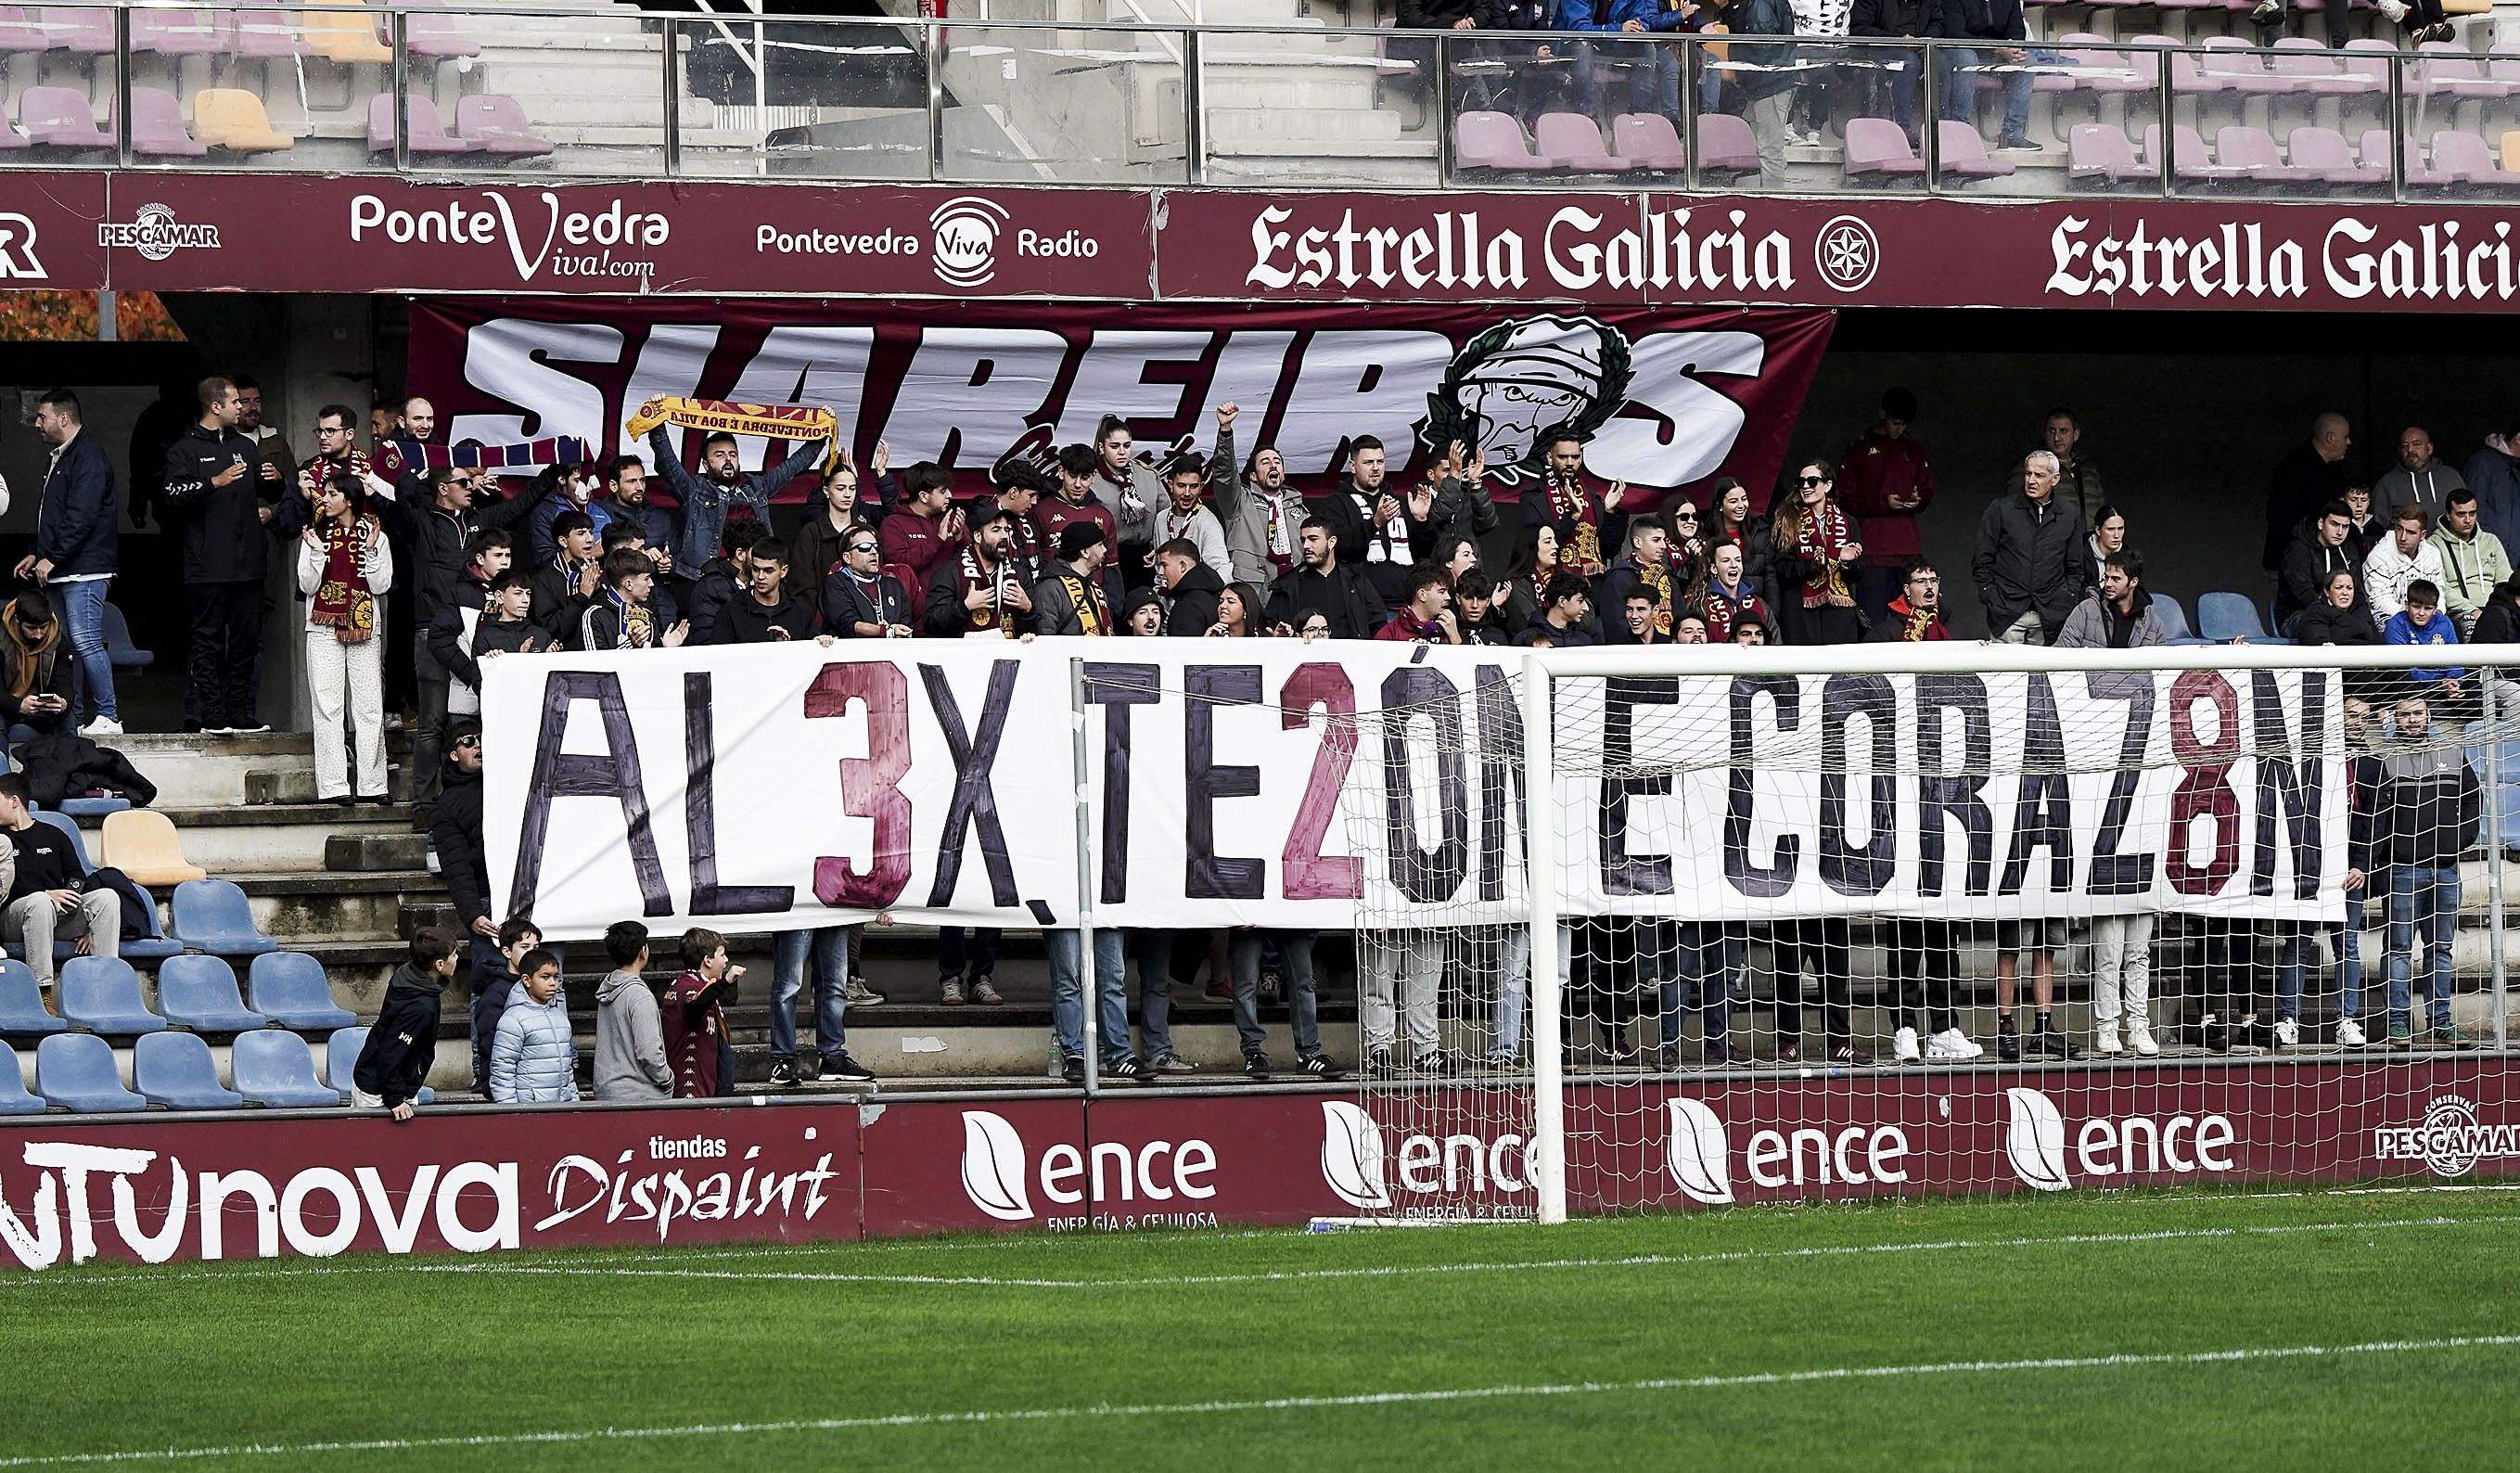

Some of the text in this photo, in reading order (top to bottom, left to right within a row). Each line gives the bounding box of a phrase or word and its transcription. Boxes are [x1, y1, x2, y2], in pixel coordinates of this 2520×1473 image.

[97, 223, 222, 249] PESCAMAR
[756, 224, 1098, 258] Pontevedra Viva Radio
[1245, 204, 1797, 292] Estrella Galicia
[2044, 214, 2520, 301] Estrella Galici
[1599, 675, 1679, 896] E
[1724, 670, 2326, 901] CORAZ8N
[2424, 1095, 2475, 1114] CONSERVAS
[649, 1134, 727, 1159] tiendas
[1040, 1138, 1217, 1203] ence
[1747, 1124, 1909, 1189] ence
[2078, 1114, 2234, 1175] ence
[533, 1145, 840, 1245] Dispaint
